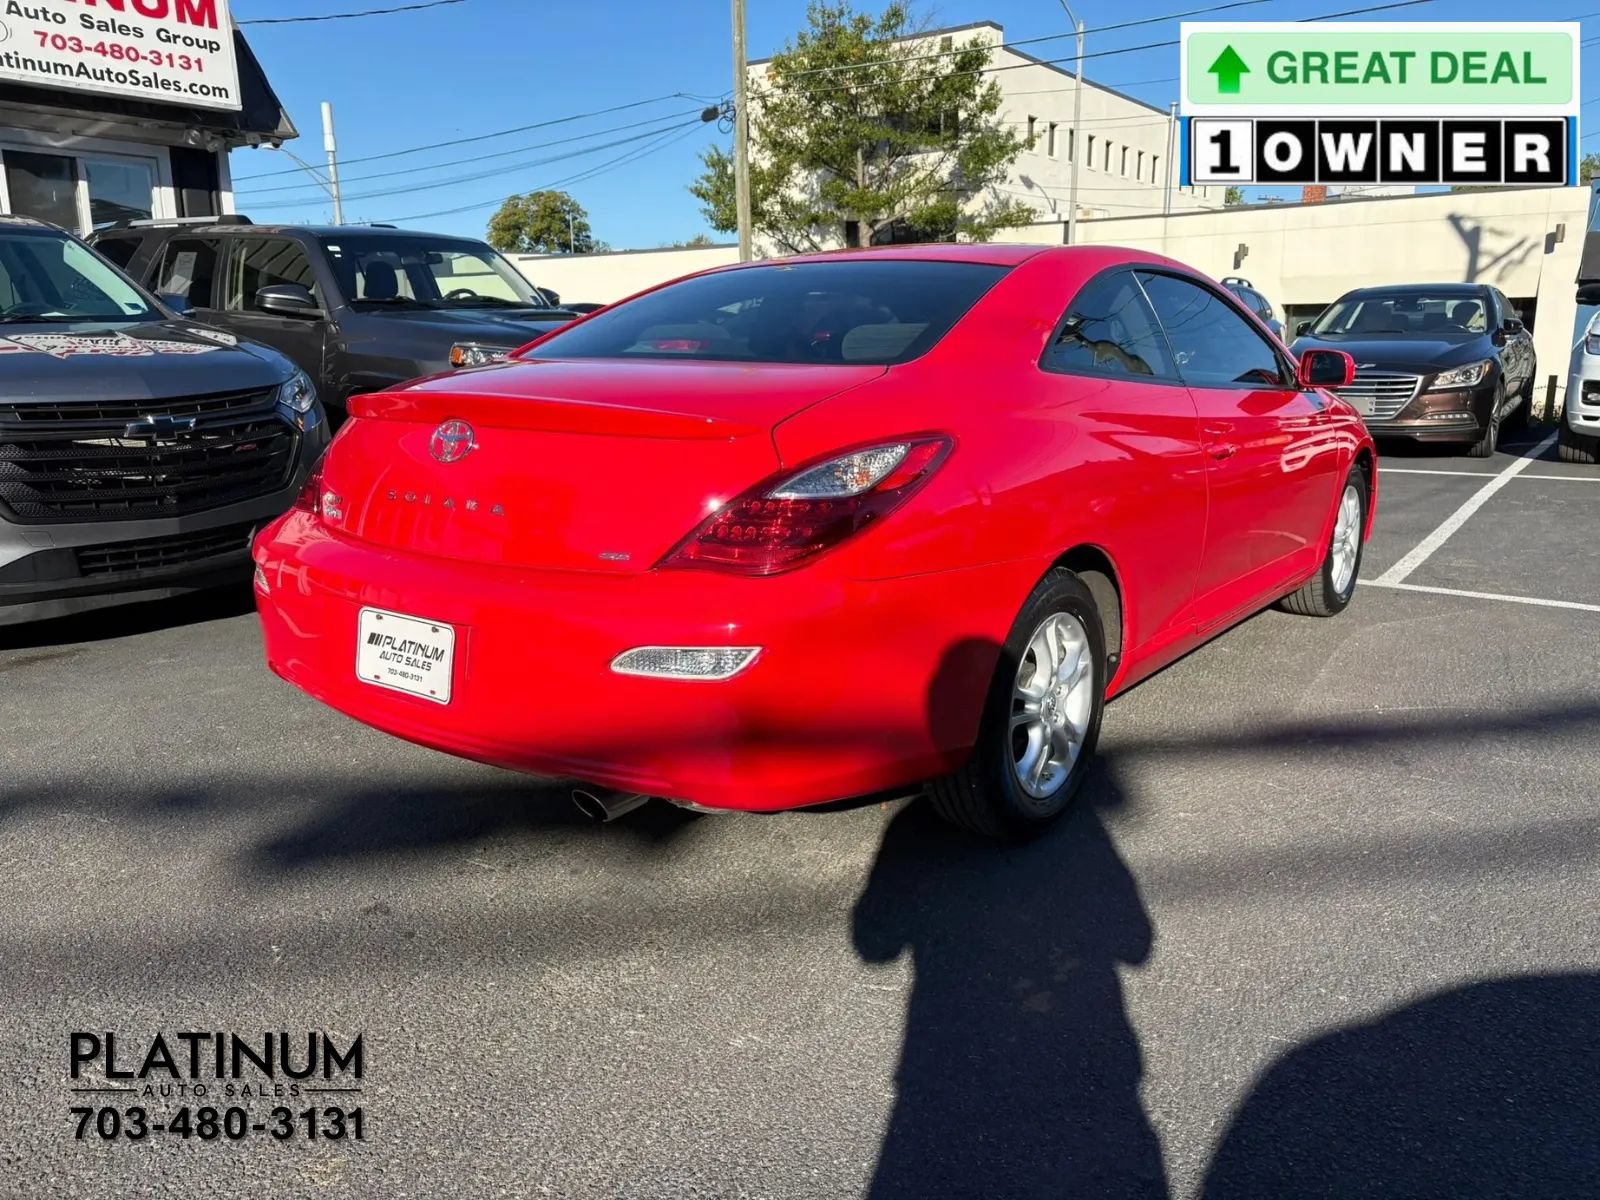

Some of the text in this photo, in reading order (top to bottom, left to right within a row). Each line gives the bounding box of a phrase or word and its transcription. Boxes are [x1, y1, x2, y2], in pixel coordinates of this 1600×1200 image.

[6, 0, 221, 54] Auto Sales Group
[33, 30, 204, 73] 703-480-3131
[387, 488, 505, 516] SOLARA
[379, 650, 432, 672] AUTO SALES
[382, 634, 445, 662] PLATINUM
